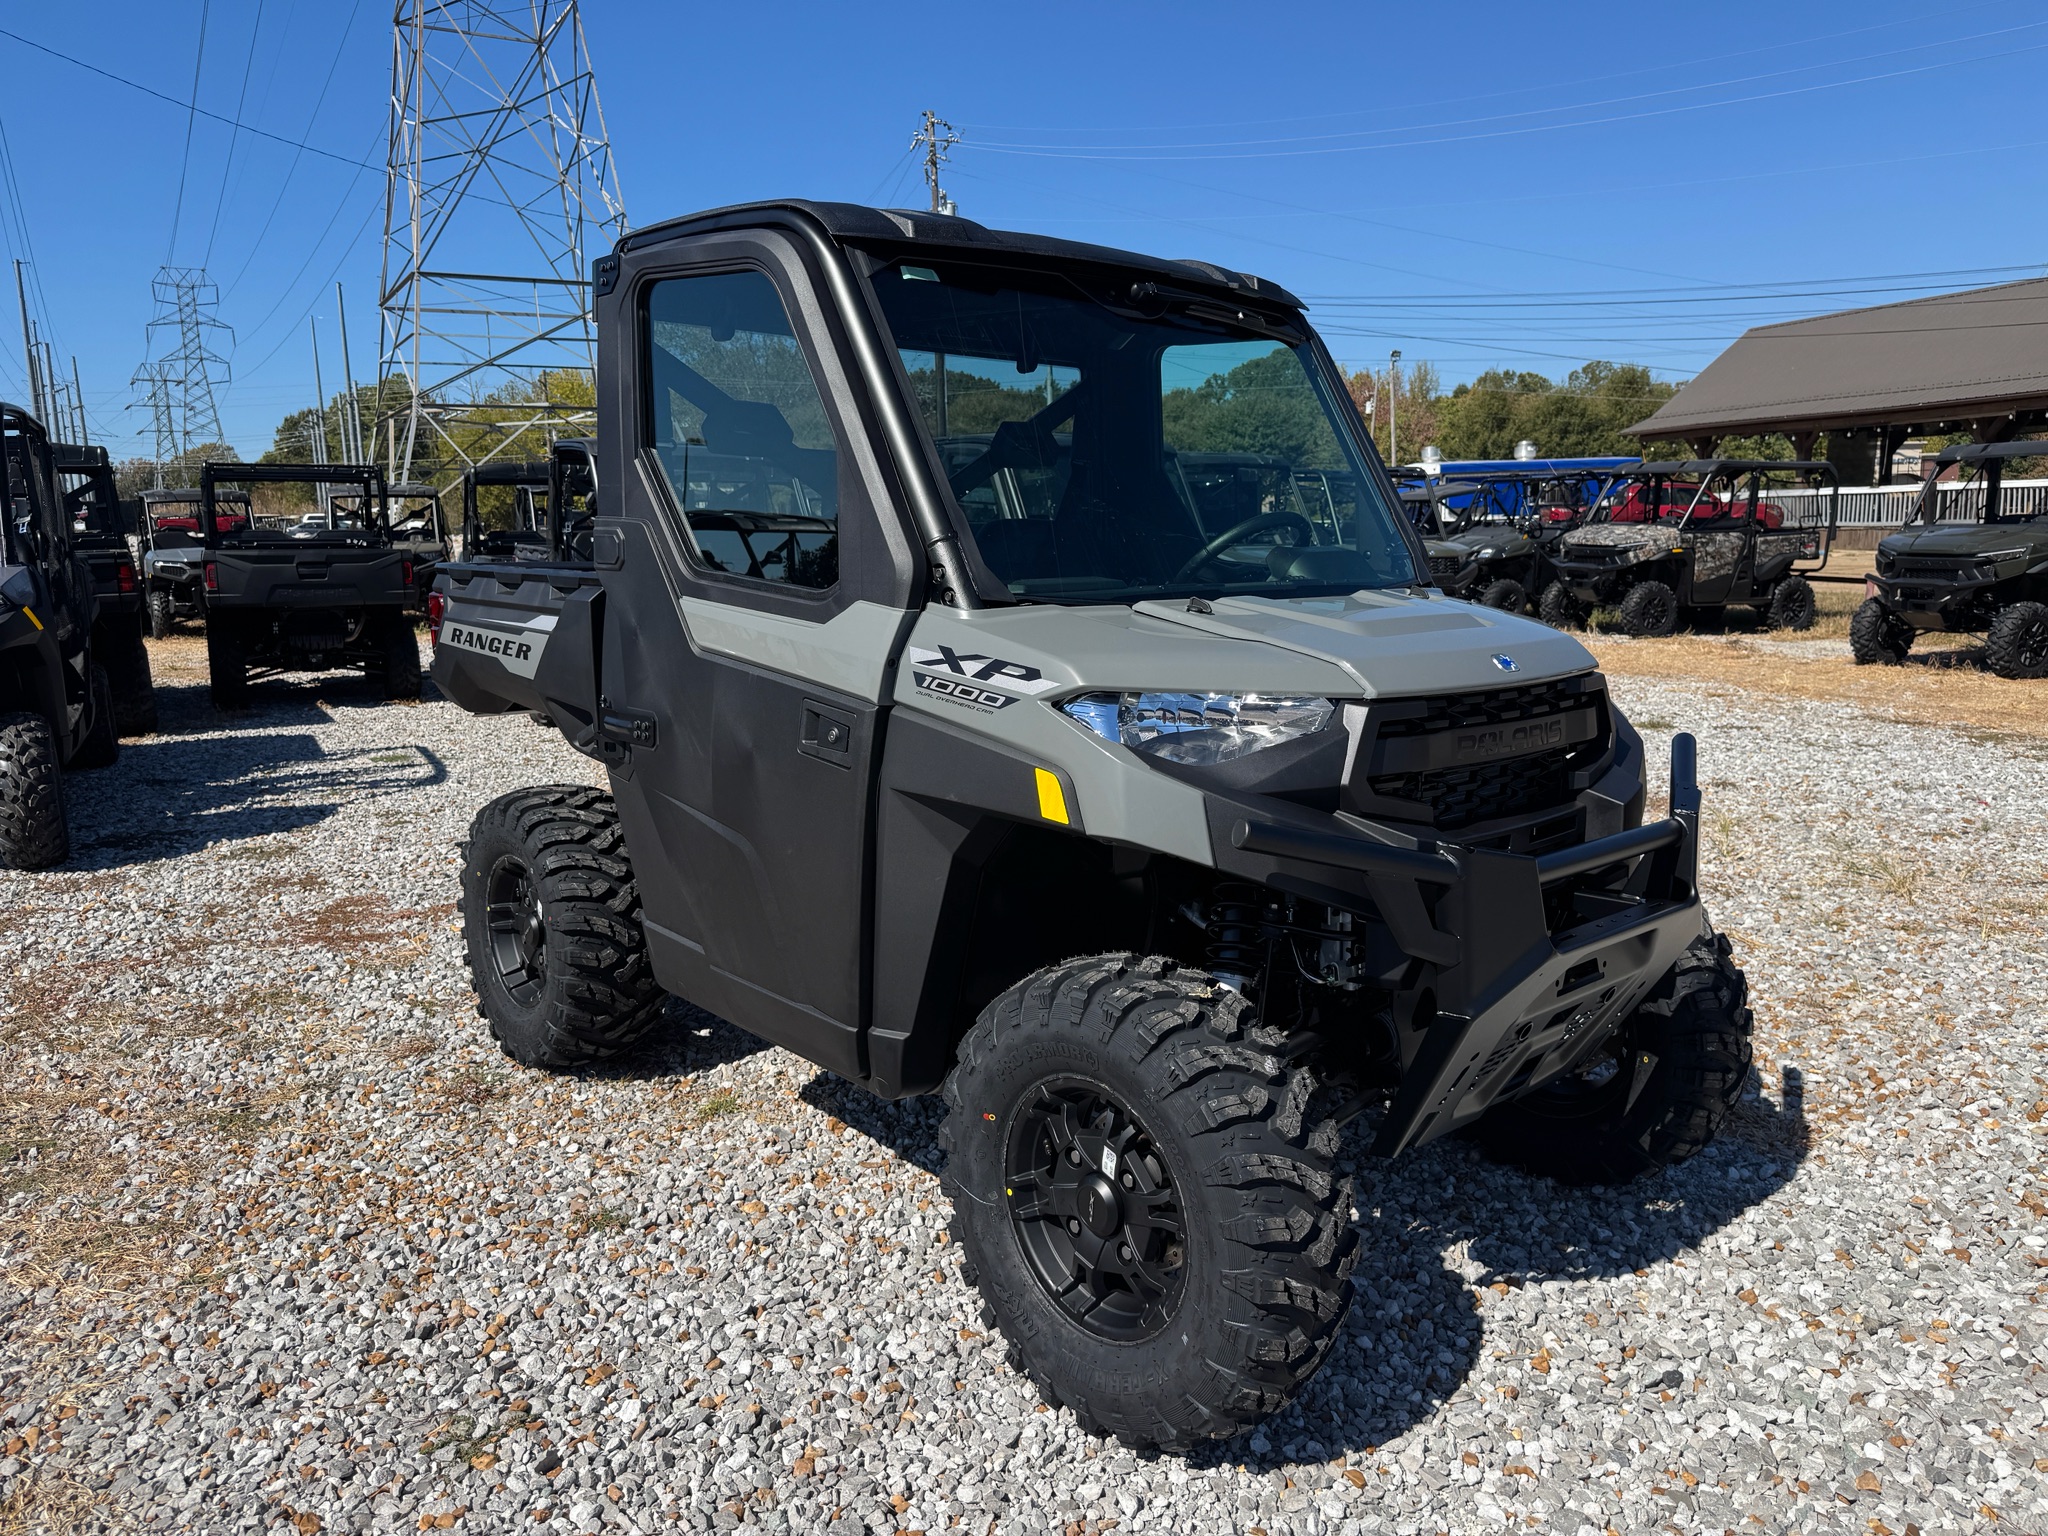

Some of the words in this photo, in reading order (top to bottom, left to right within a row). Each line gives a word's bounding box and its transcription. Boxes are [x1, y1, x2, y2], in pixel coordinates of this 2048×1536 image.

[451, 627, 532, 661] RANGER
[914, 644, 1042, 682] XP
[915, 690, 934, 699] DUAL
[935, 695, 976, 711] OVERHEAD
[976, 706, 994, 716] CAM
[921, 675, 1006, 708] 1000
[1457, 719, 1562, 760] POLARIS
[1022, 1040, 1083, 1063] ARMOR
